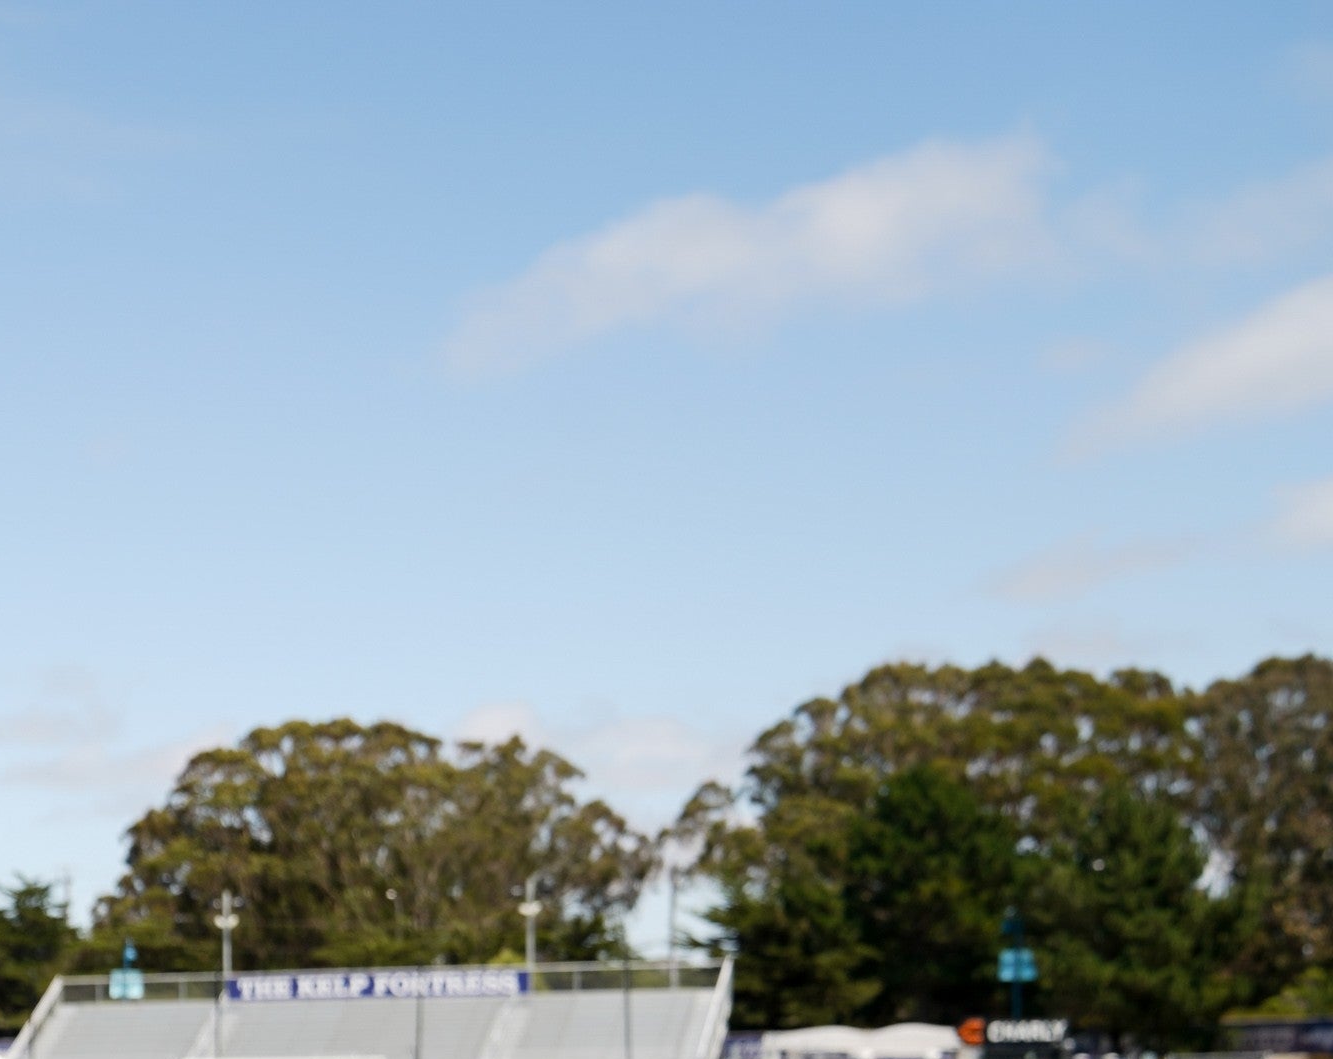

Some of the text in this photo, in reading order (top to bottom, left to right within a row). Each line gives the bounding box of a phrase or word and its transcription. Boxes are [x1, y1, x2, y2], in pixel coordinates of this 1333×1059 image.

[238, 970, 518, 999] THE KELP FORTRESS
[987, 1018, 1068, 1043] CHARLY
